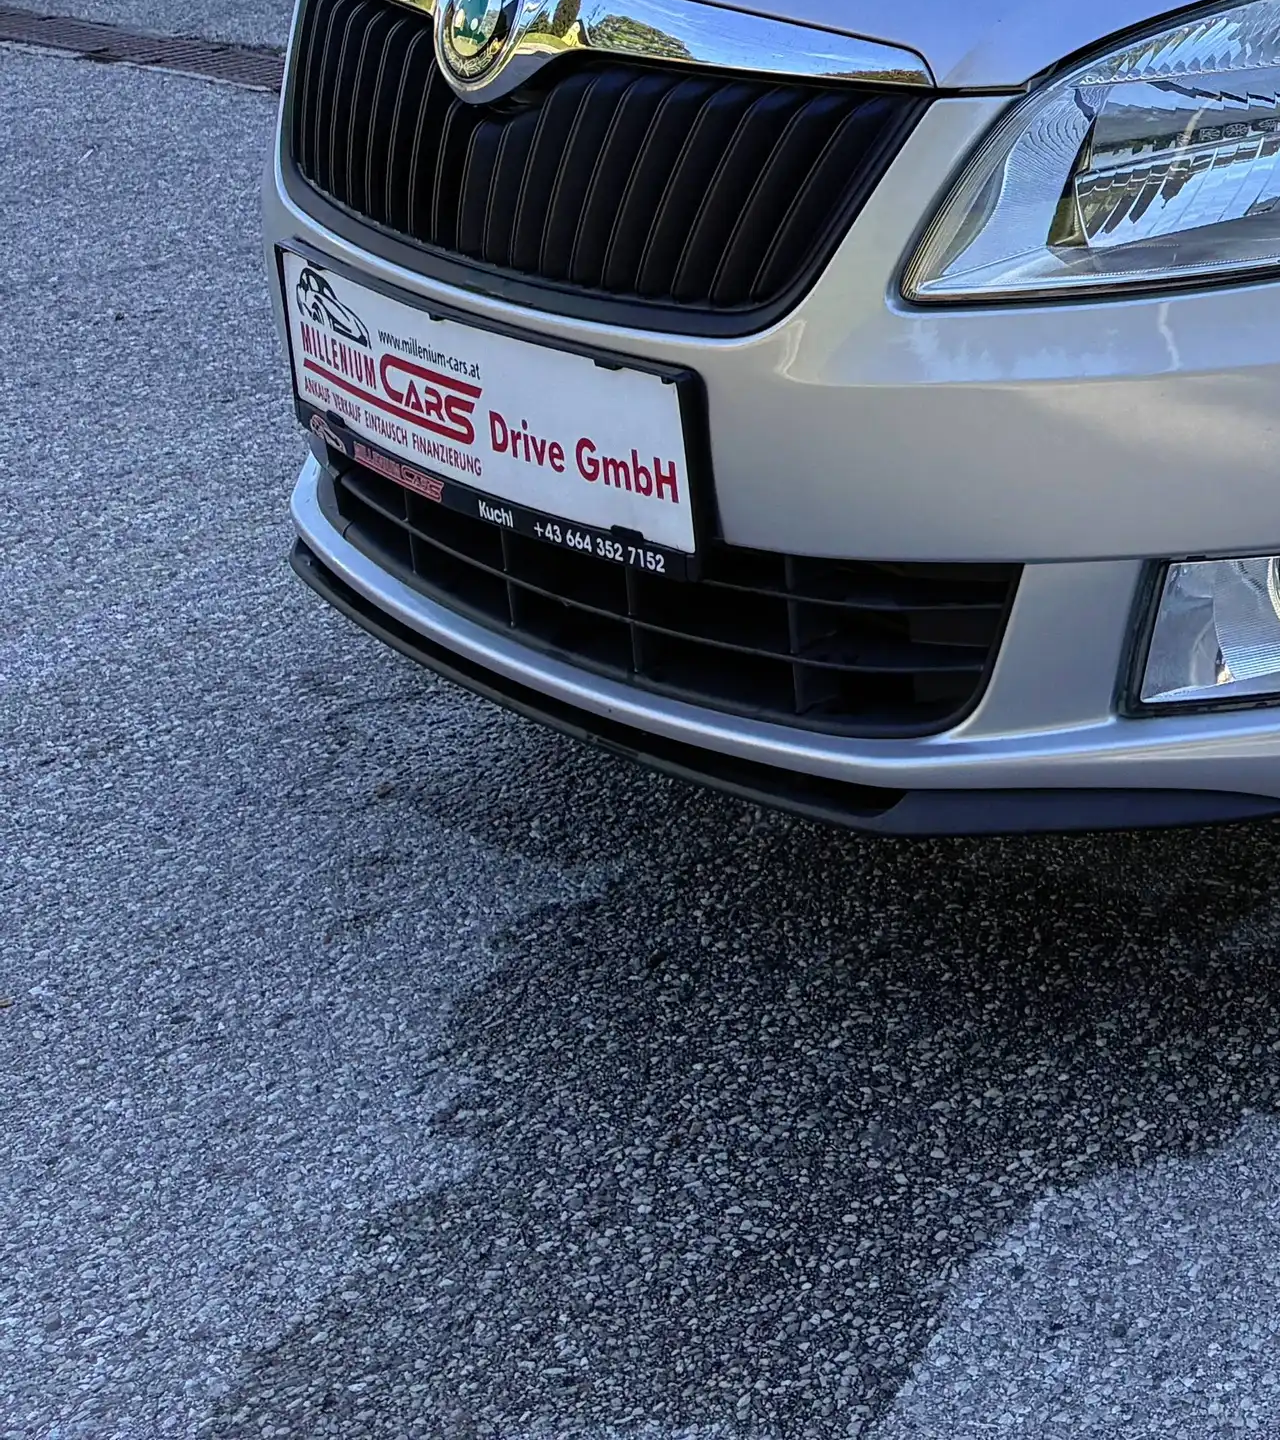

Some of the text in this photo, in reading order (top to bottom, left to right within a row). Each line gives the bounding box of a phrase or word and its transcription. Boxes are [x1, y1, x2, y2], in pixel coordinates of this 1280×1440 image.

[300, 321, 483, 445] MILLENIUM CARS
[378, 329, 481, 380] www.millenium-cars.at
[304, 375, 482, 477] ANKAUF VERKAUF EINTAUSCH FINANZIERUNG
[489, 410, 679, 504] Drive GmbH
[478, 499, 666, 573] Kuchl +43 664 352 7152
